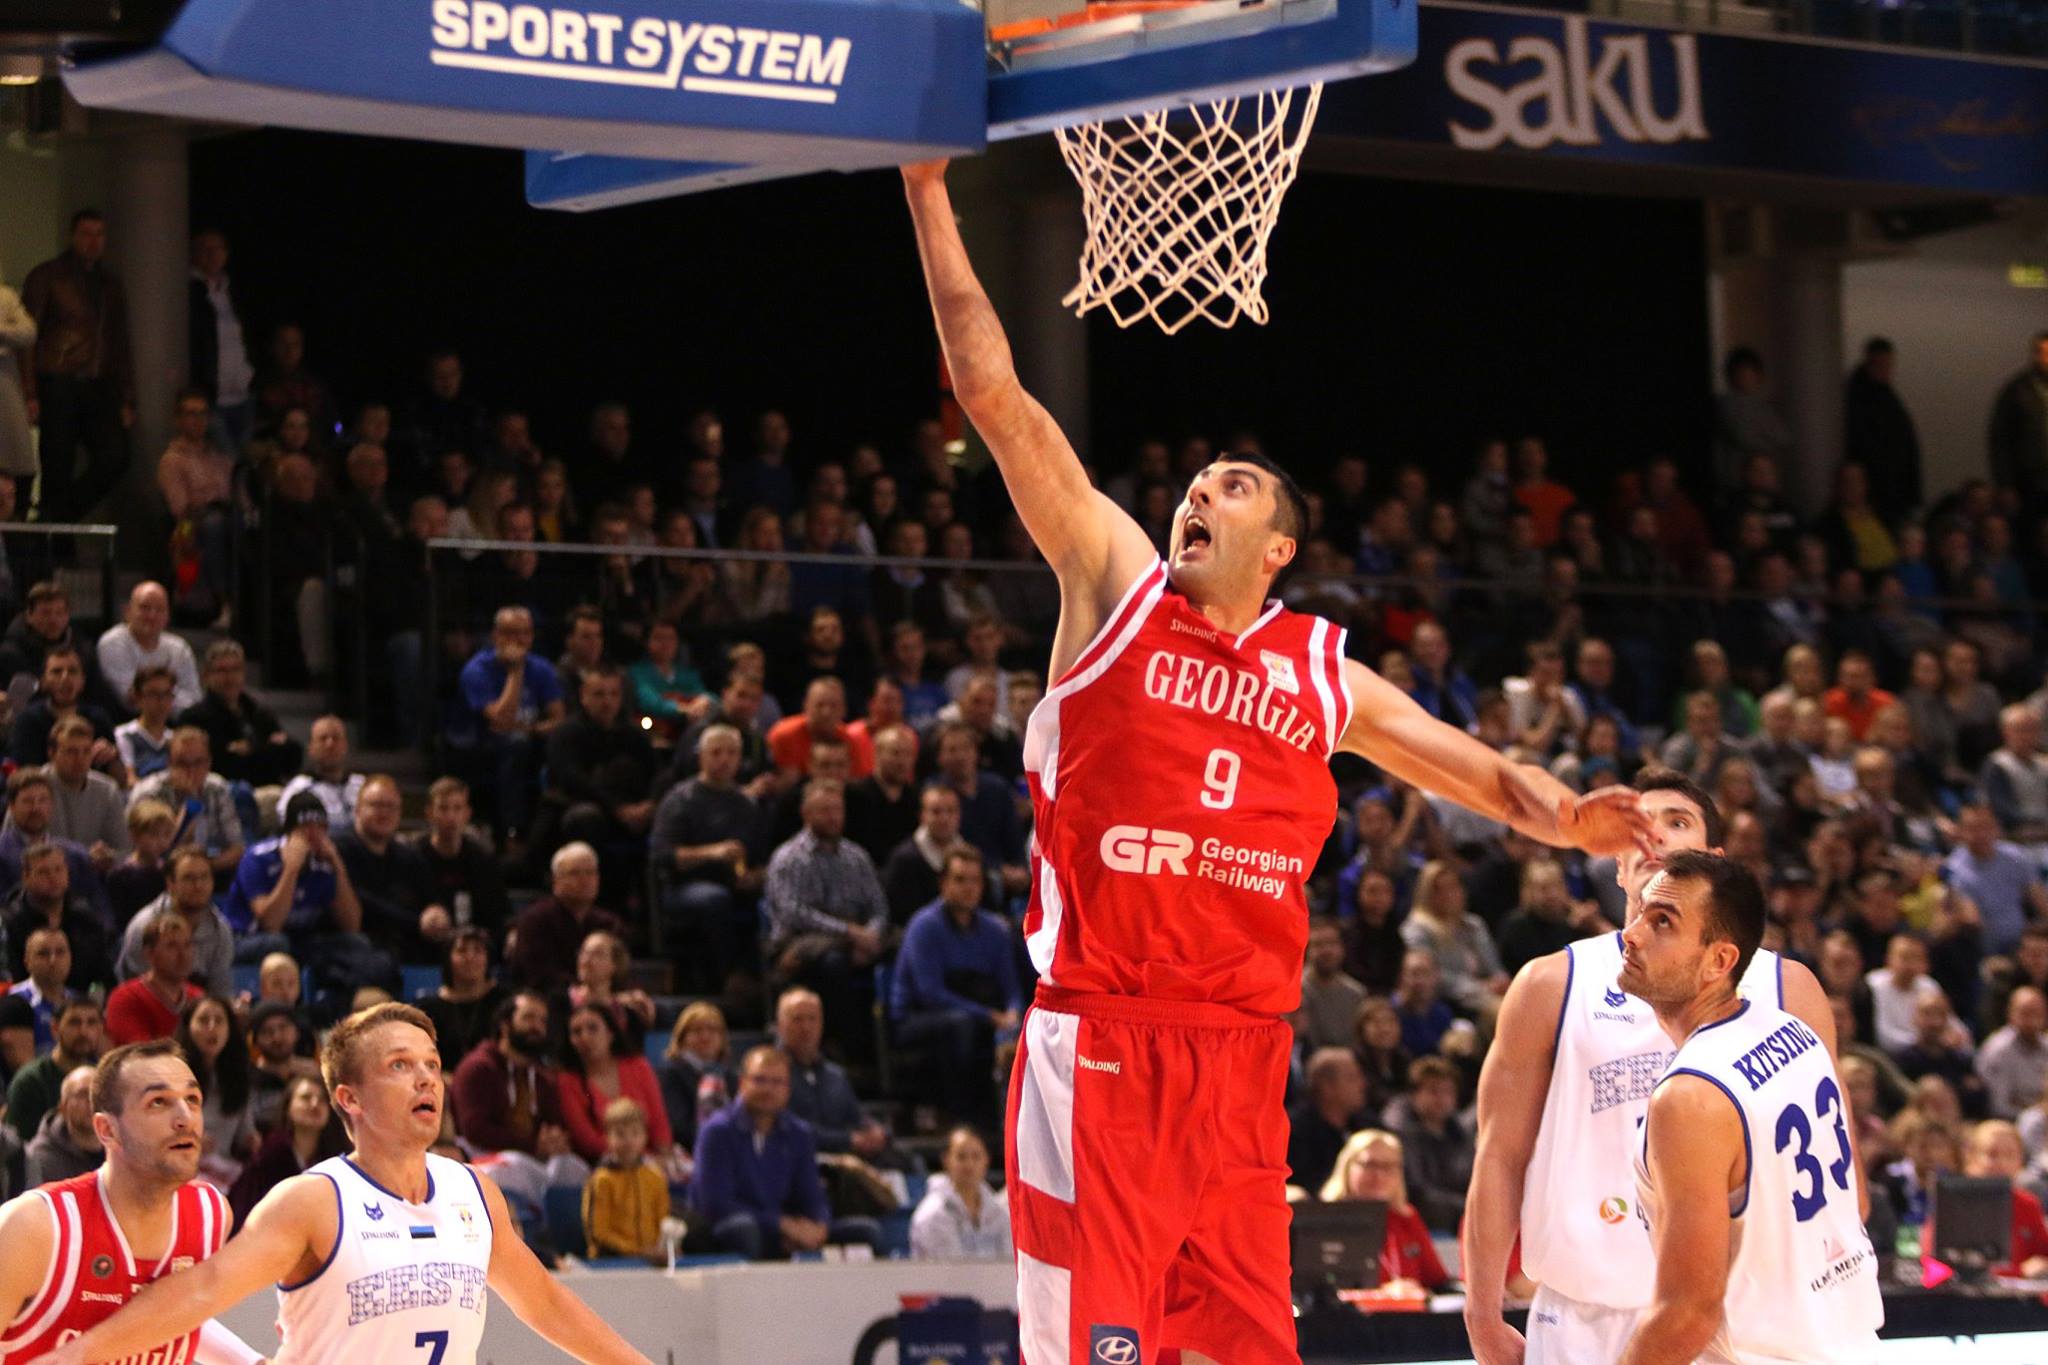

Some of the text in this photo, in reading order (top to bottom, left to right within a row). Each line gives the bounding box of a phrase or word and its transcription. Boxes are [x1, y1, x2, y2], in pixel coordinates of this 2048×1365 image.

[432, 0, 852, 88] SPORT SYSTEM
[1444, 15, 1709, 150] saku
[1170, 618, 1218, 643] SPALDING
[1144, 650, 1316, 752] GEORGIA
[1200, 748, 1241, 810] 9
[1100, 824, 1194, 876] GR
[1201, 837, 1303, 874] Georgian
[1197, 860, 1286, 900] Railway
[1775, 1076, 1852, 1222] 33
[414, 1330, 449, 1365] 7
